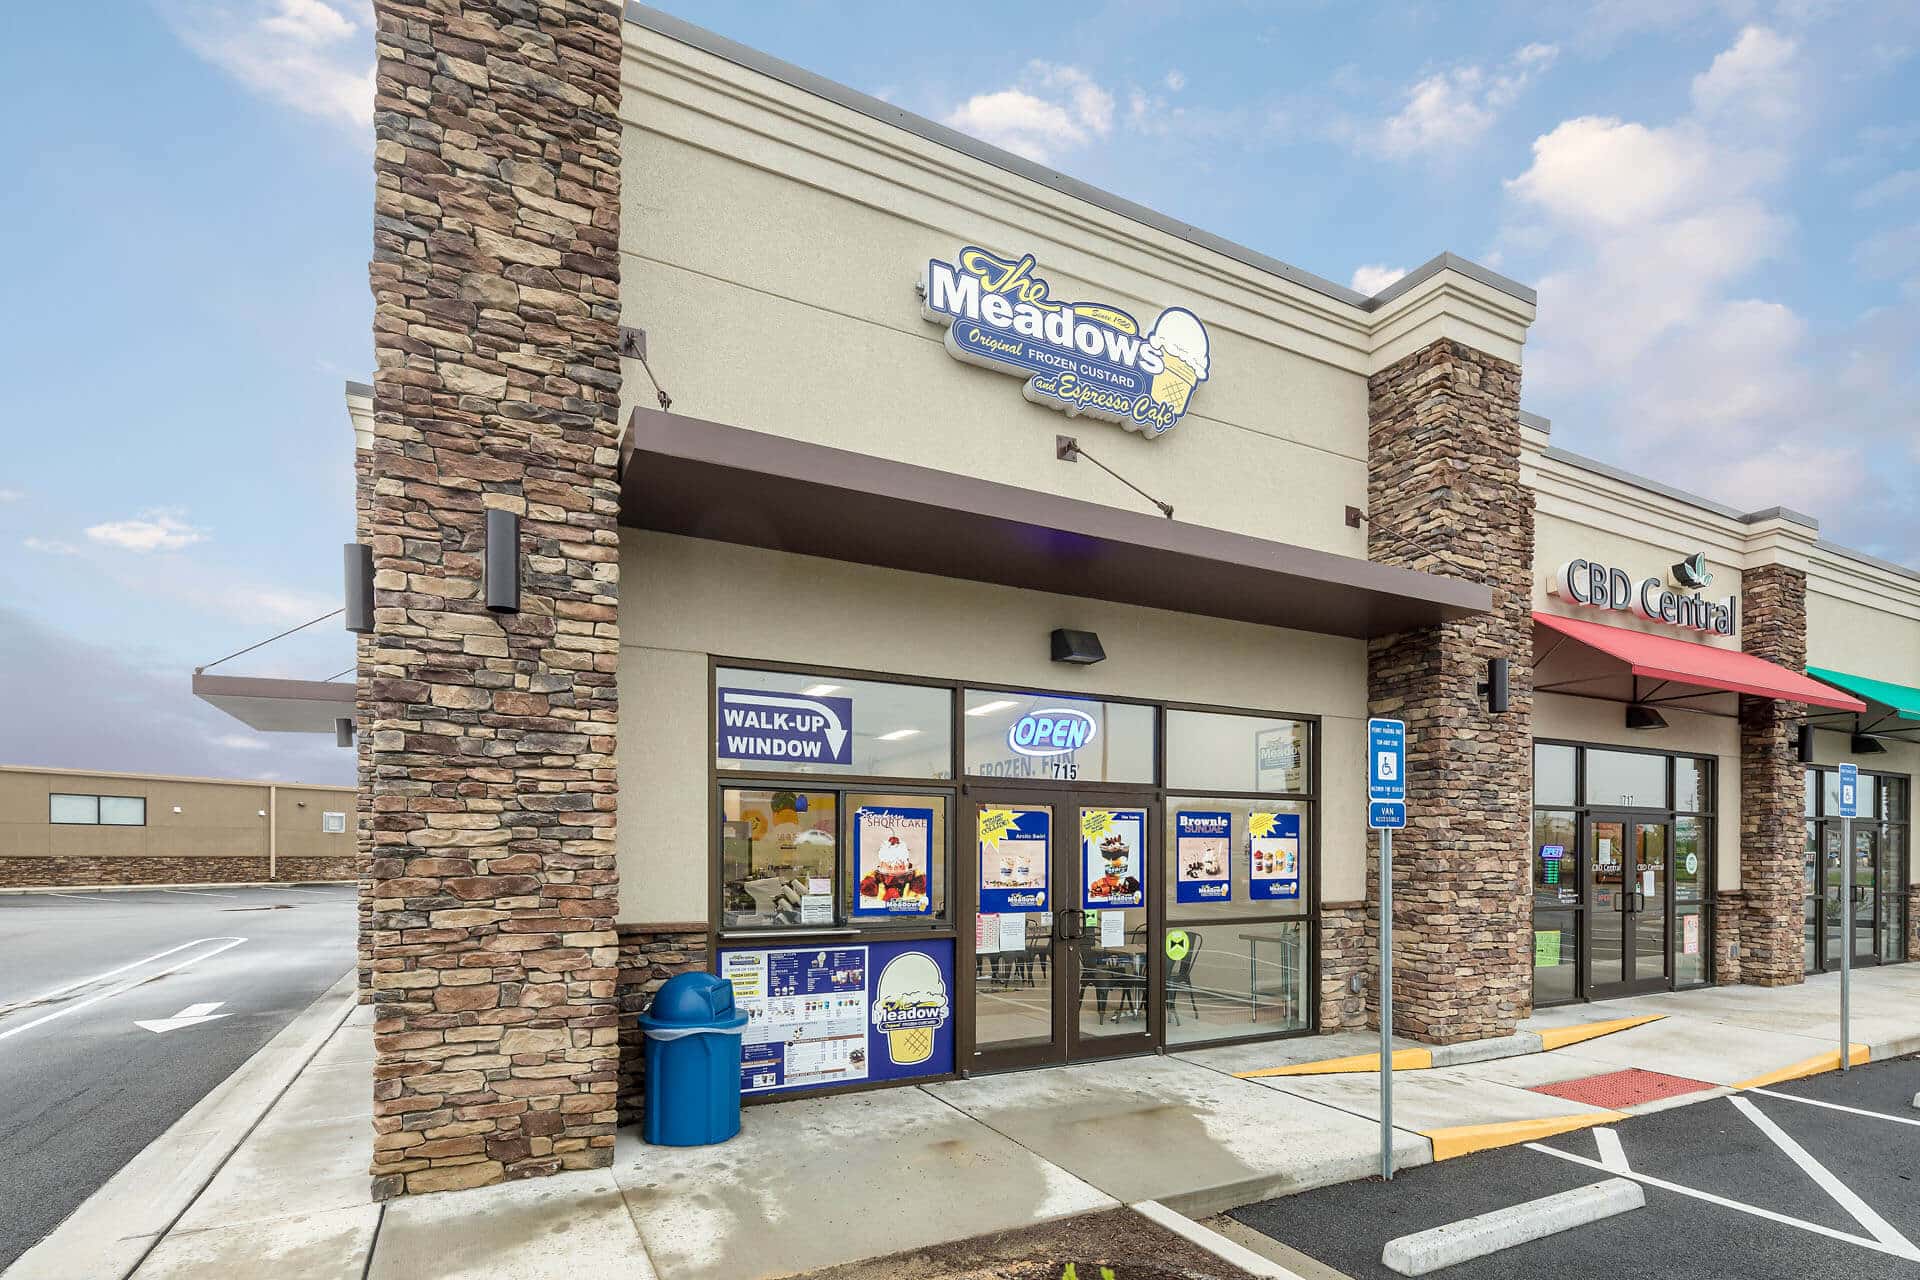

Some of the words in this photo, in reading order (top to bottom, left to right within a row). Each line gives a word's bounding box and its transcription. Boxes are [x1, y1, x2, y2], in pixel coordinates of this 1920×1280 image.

[963, 251, 1060, 311] The
[933, 265, 1166, 374] Meadows
[969, 329, 1023, 357] Original
[1028, 349, 1077, 372] FROZEN
[1080, 364, 1135, 388] CUSTARD
[1035, 379, 1056, 393] and
[1059, 375, 1130, 409] Espresso
[1133, 397, 1175, 430] Café
[1567, 558, 1632, 610] CBD
[1640, 577, 1737, 635] Central
[724, 708, 825, 733] WALK-UP
[1015, 716, 1088, 748] OPEN
[727, 735, 822, 758] WINDOW
[1054, 763, 1077, 780] 715
[867, 817, 927, 828] SHORTCAKE
[1180, 816, 1228, 826] Brownie
[1381, 807, 1394, 815] VAN
[1184, 825, 1225, 833] SUNDAE
[874, 1006, 949, 1022] Meadows
